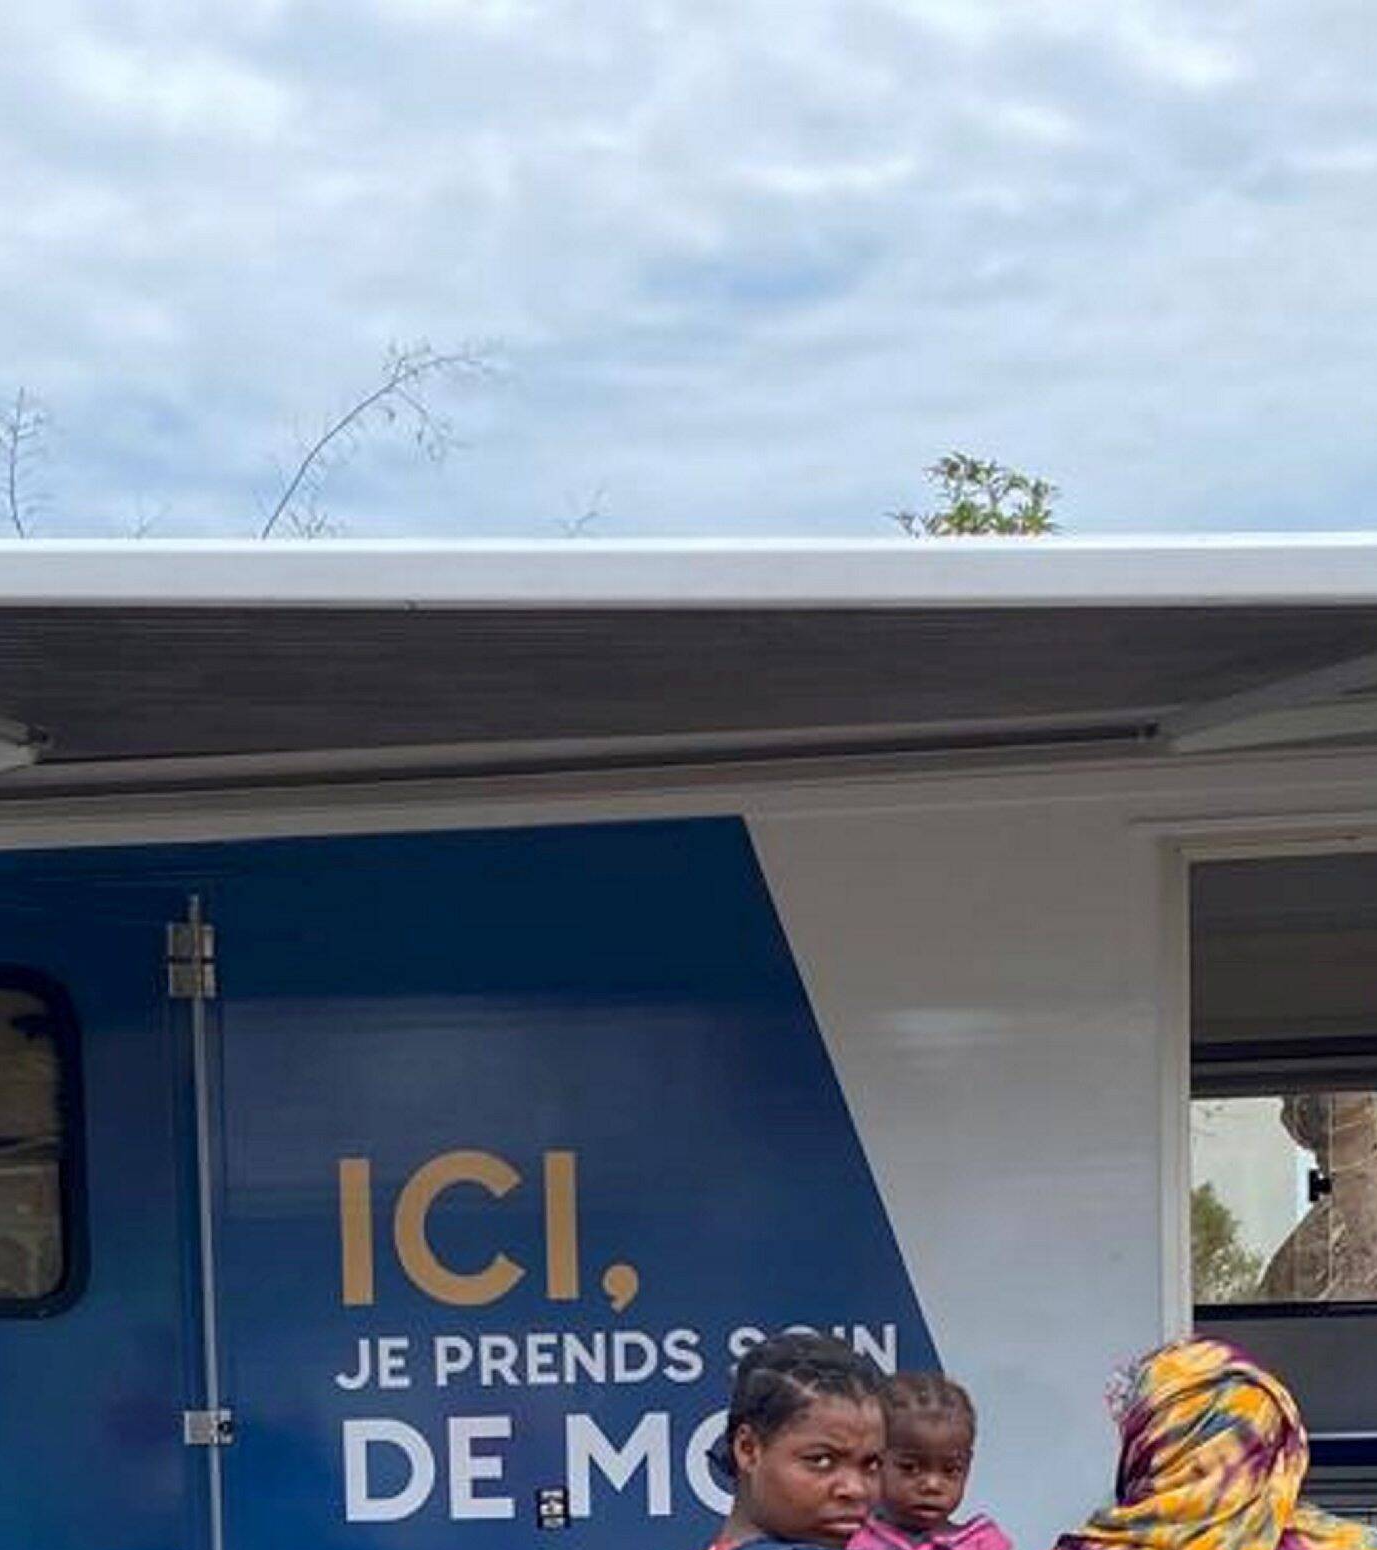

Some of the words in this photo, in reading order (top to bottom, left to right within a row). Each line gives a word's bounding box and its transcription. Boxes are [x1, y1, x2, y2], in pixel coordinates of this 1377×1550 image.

[339, 1149, 639, 1311] ICI,
[336, 1337, 410, 1390] JE
[435, 1329, 704, 1387] PRENDS
[729, 1324, 897, 1376] SN
[342, 1415, 516, 1522] DE
